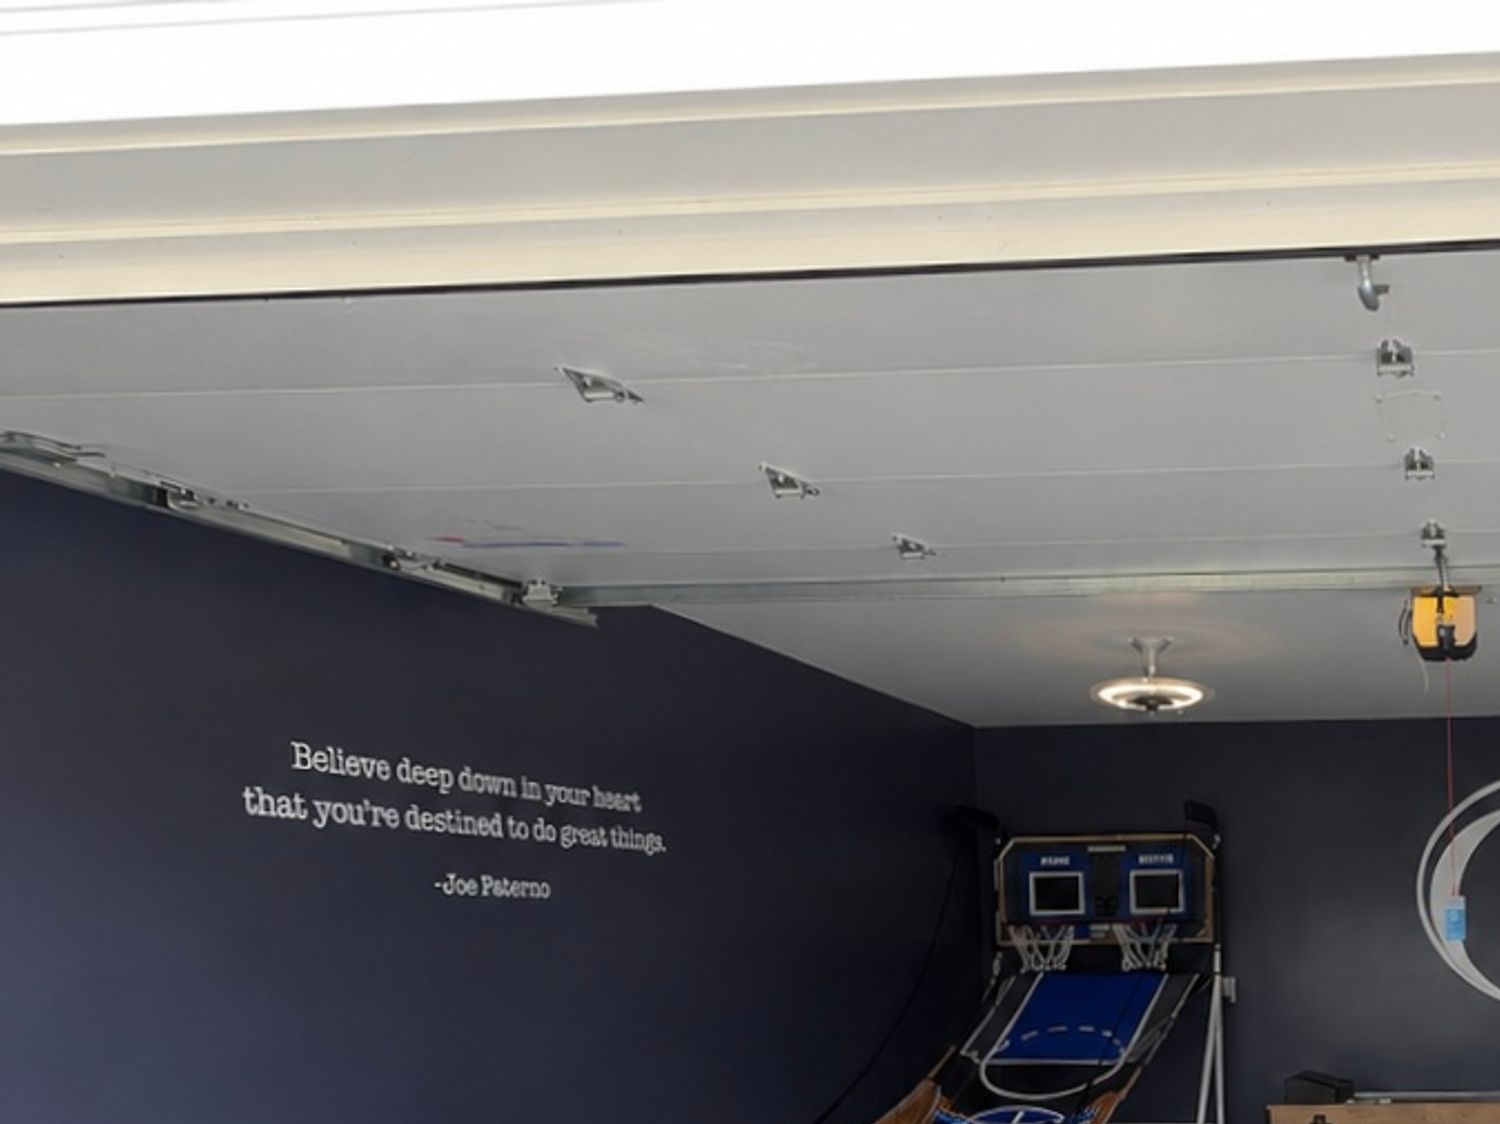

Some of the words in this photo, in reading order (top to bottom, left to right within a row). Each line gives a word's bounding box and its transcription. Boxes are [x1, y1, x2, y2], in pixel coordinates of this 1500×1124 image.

[290, 741, 391, 781] Believe
[396, 758, 454, 794] deep
[458, 766, 517, 797] down
[521, 778, 542, 801] in
[544, 781, 591, 807] your
[593, 785, 643, 812] heart
[242, 785, 308, 819] that
[312, 799, 400, 829] you're
[405, 804, 503, 838] destined
[507, 814, 529, 840] to
[533, 817, 557, 843] do
[560, 824, 608, 849] great
[610, 825, 667, 856] things.
[481, 874, 551, 899] Paterno
